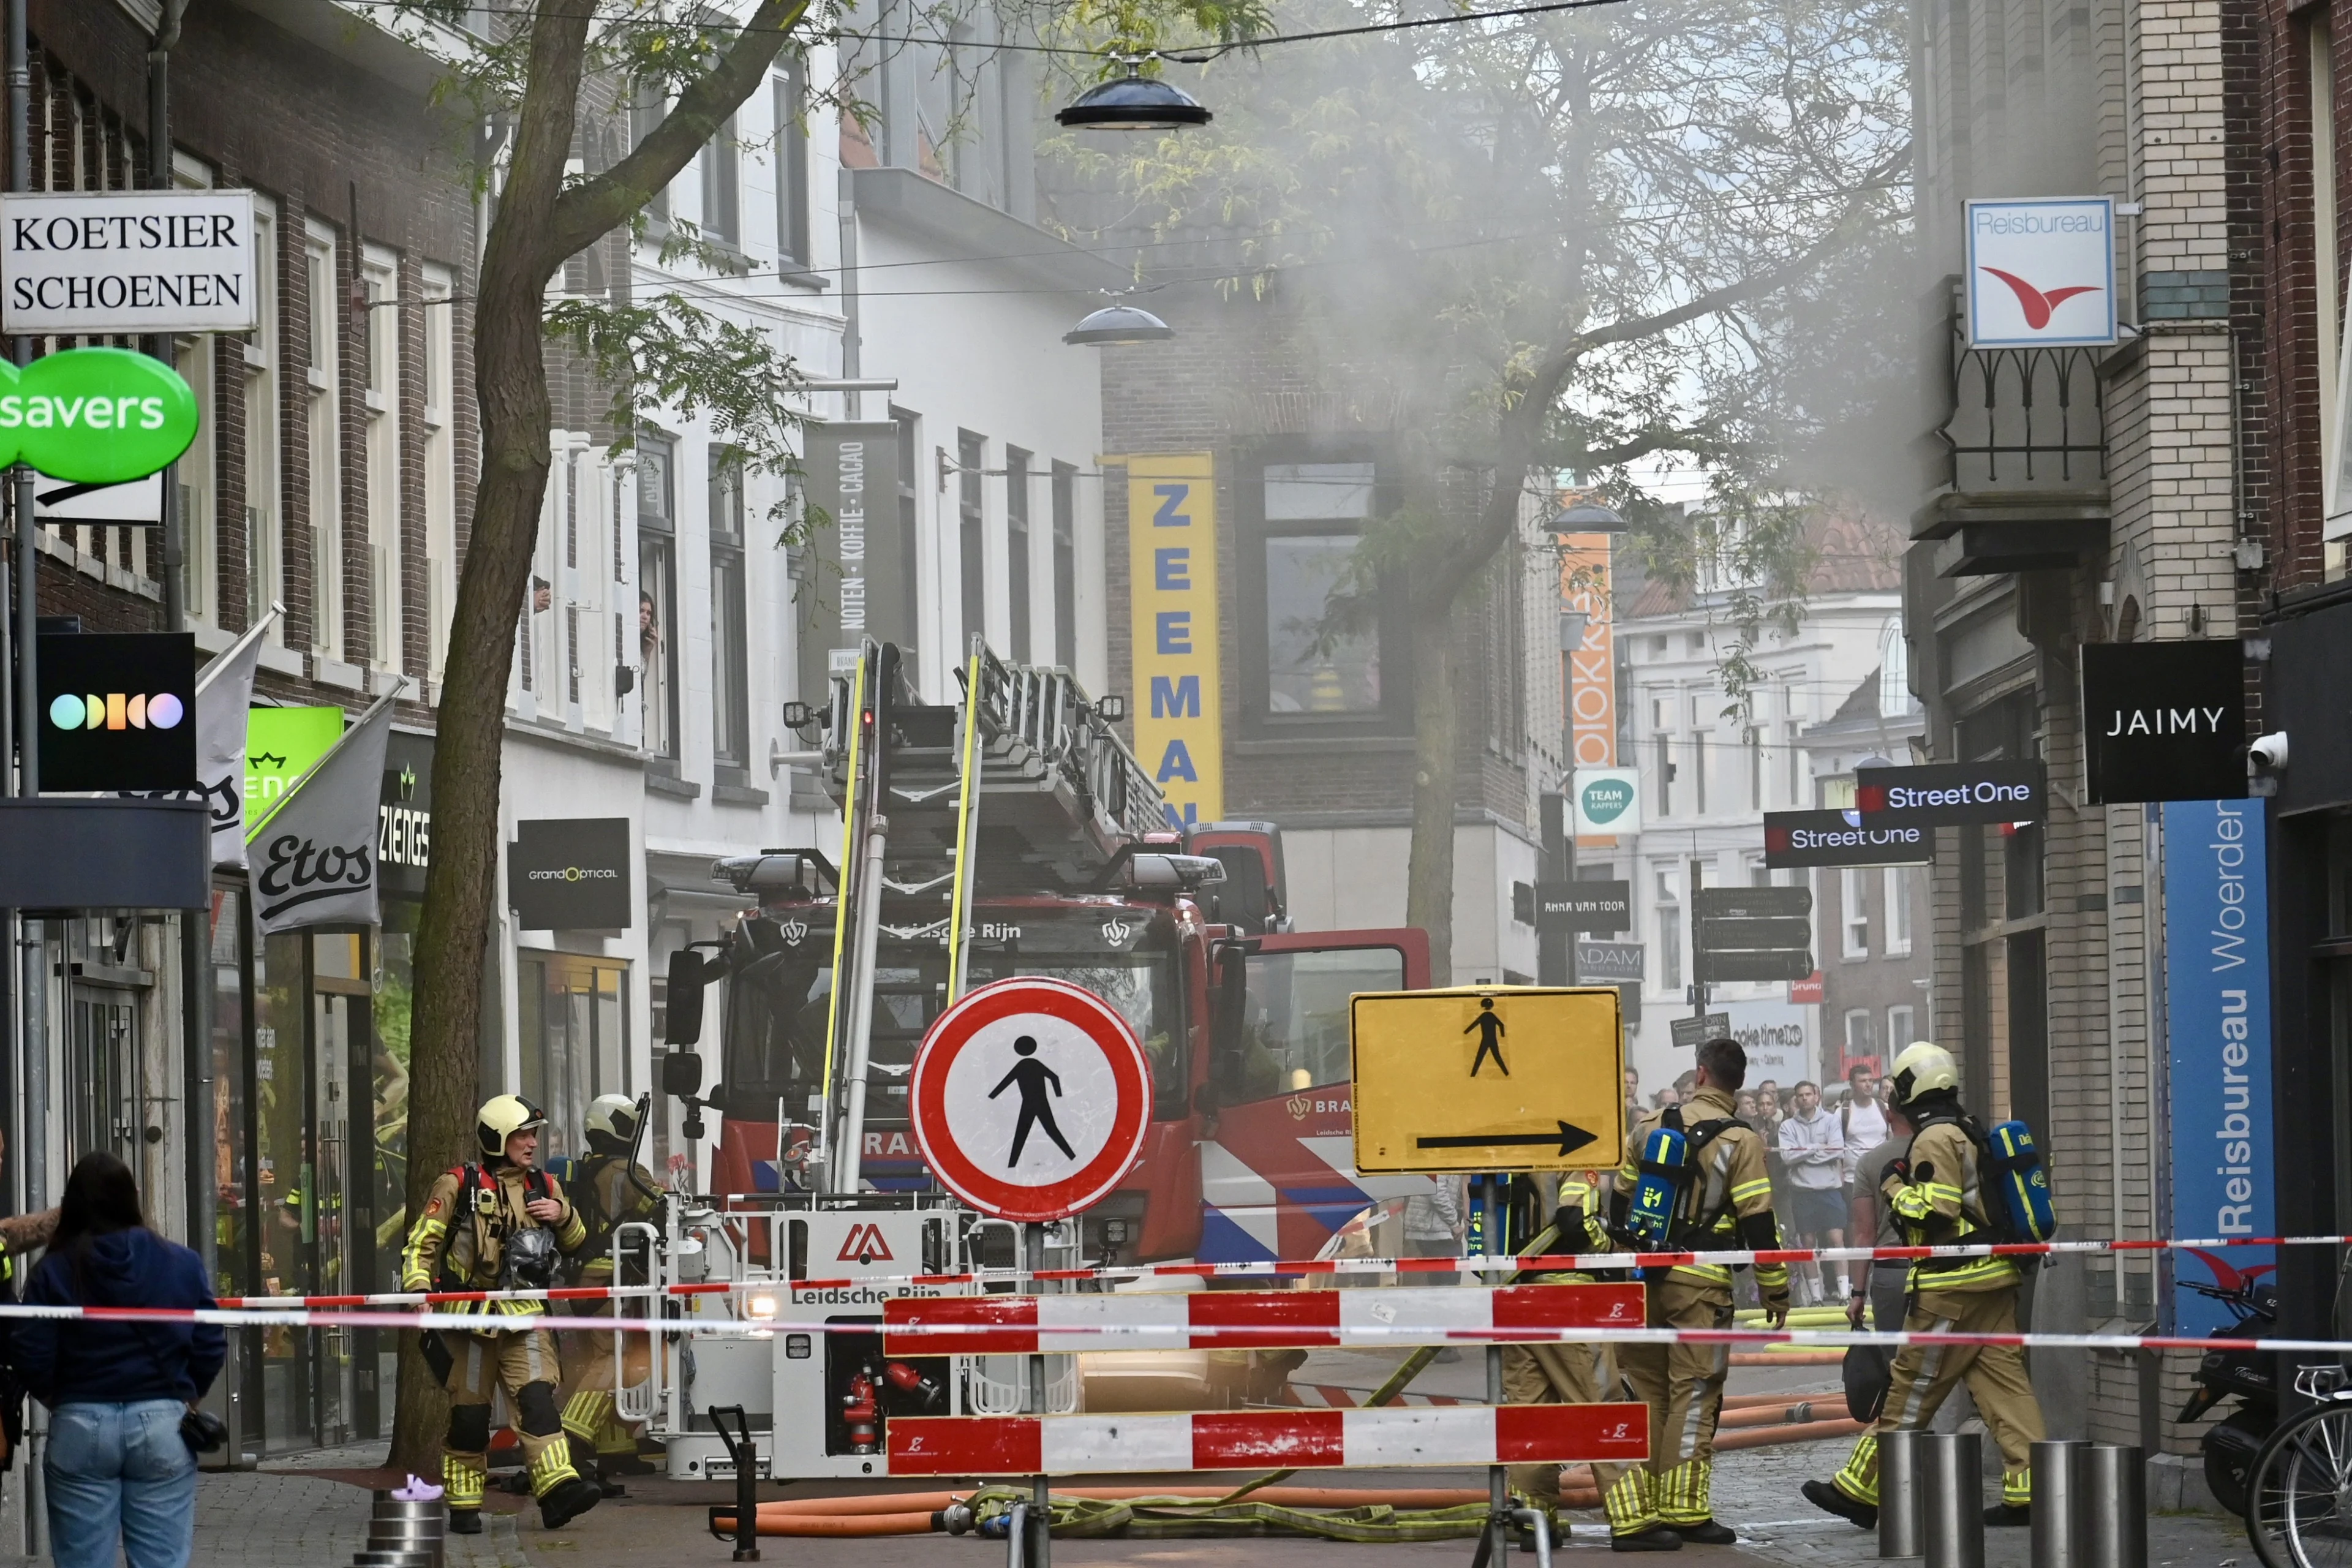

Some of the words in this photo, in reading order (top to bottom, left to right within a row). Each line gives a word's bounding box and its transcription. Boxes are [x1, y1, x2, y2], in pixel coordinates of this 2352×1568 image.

[12, 214, 240, 251] KOETSIER
[1977, 213, 2102, 235] Reisbureau
[13, 273, 243, 310] SCHOENEN
[0, 395, 165, 429] savers
[839, 442, 864, 492] CACAO
[839, 508, 864, 559] KOFFIE
[840, 578, 865, 629] NOTEN
[2107, 707, 2225, 737] JAIMY
[1589, 790, 1623, 801] TEAM
[1889, 787, 1970, 809] Street
[1974, 782, 2030, 804] One
[379, 805, 430, 867] ZIENGS
[1792, 829, 1866, 850] Street
[1869, 828, 1920, 845] One
[258, 835, 371, 896] Etos
[1545, 902, 1572, 912] ANNA
[1576, 902, 1596, 911] VAN
[1600, 901, 1625, 911] TOOR
[982, 924, 1020, 942] Rijn
[2217, 989, 2253, 1234] Reisbureau
[792, 1287, 889, 1305] Leidsche
